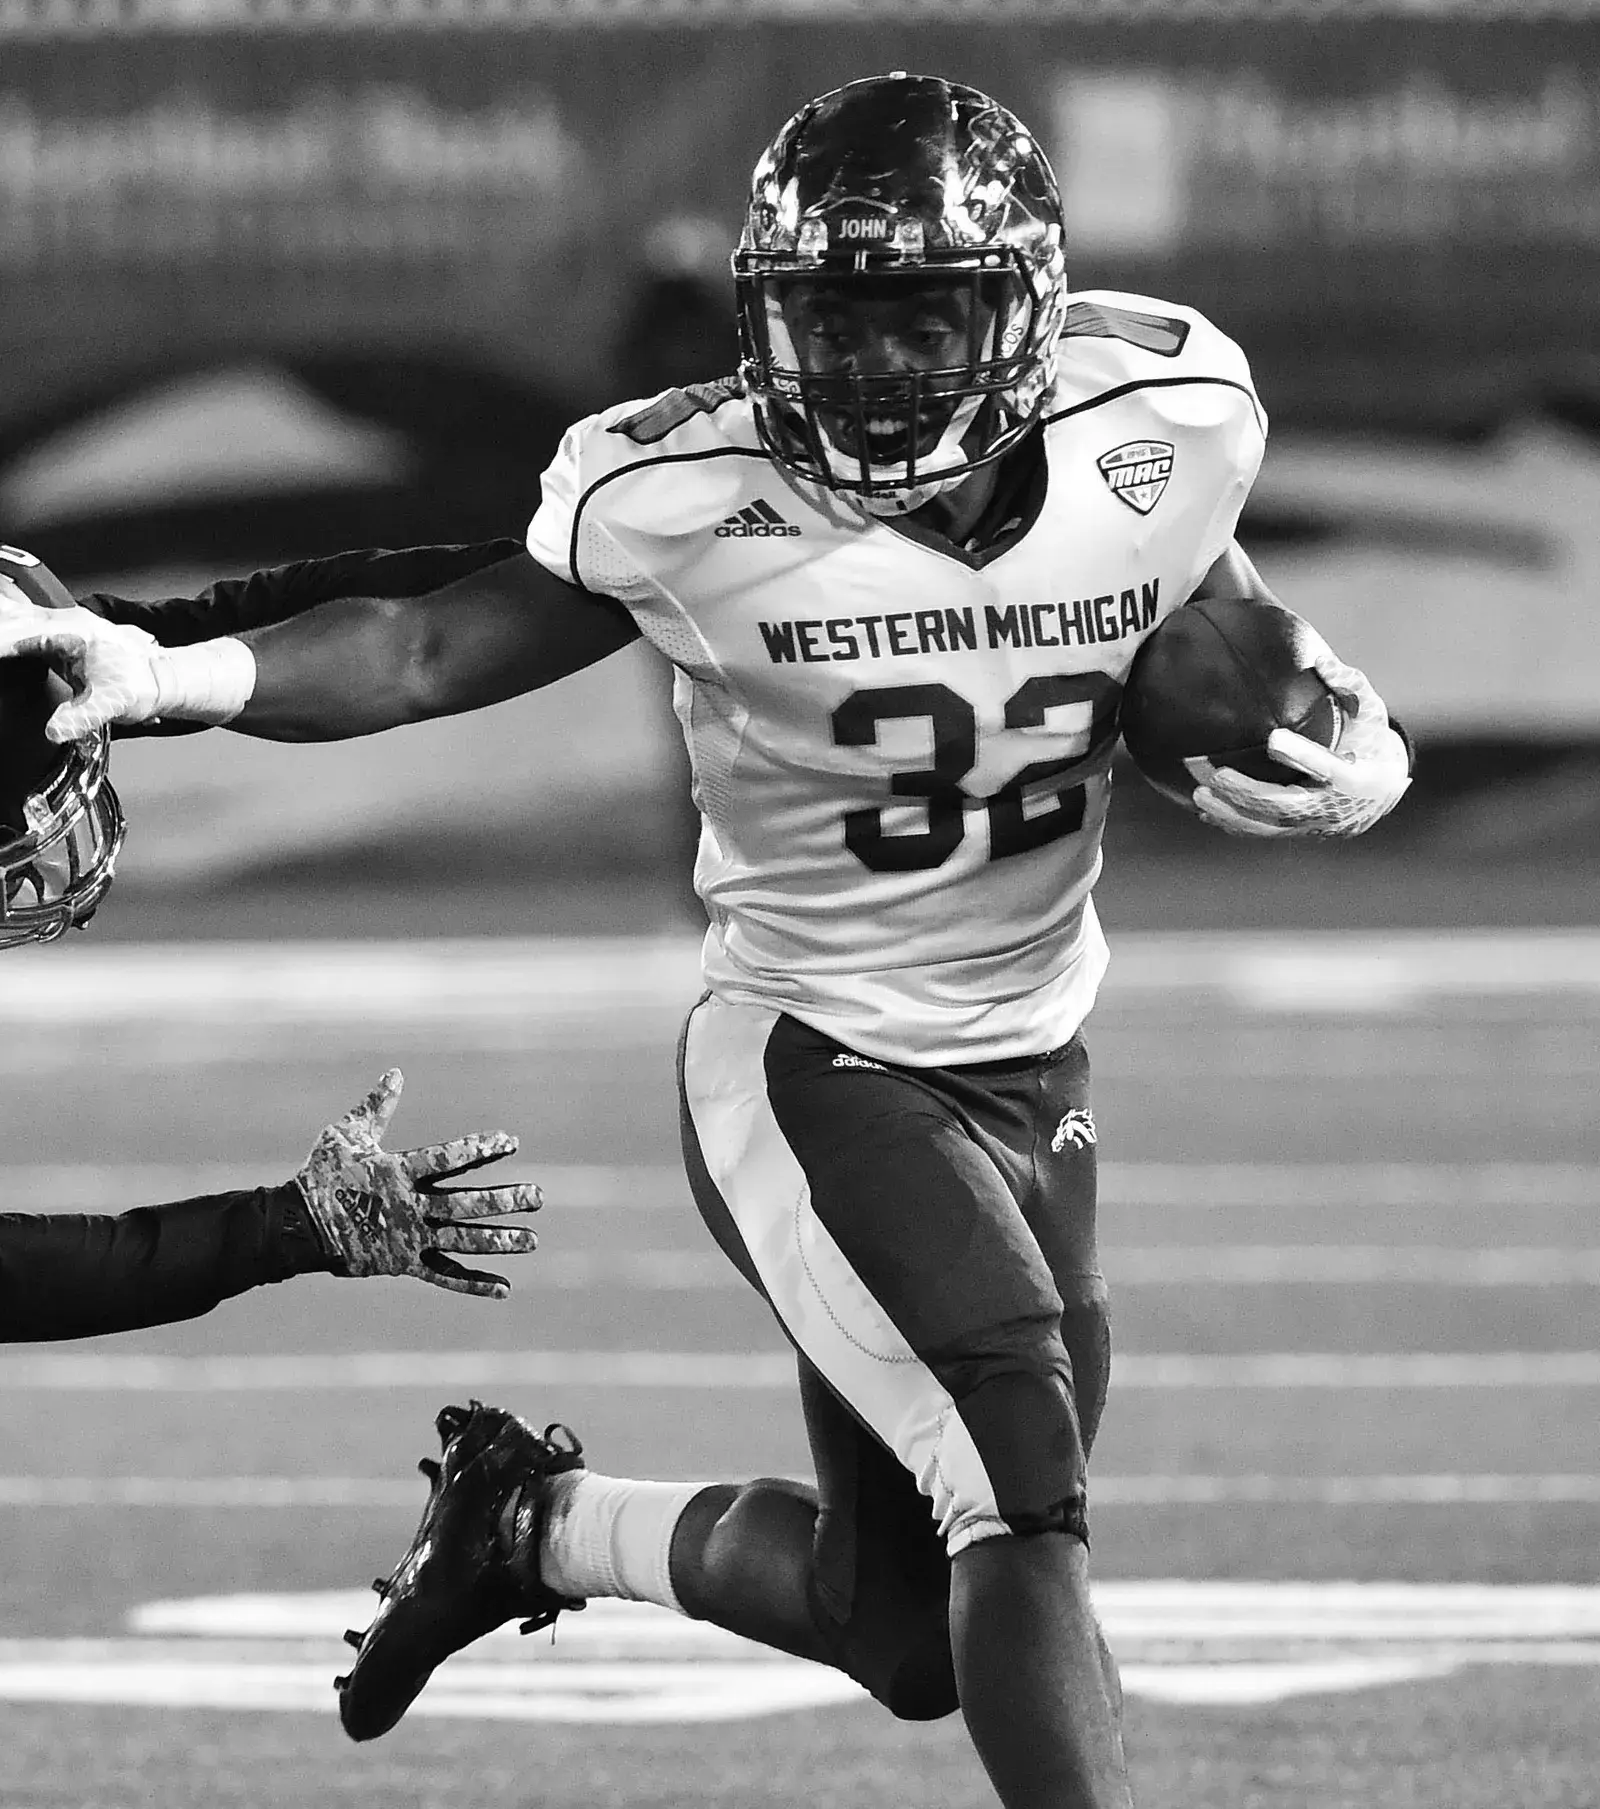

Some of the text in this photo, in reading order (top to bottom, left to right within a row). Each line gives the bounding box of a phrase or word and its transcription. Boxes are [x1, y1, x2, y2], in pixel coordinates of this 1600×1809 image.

[838, 218, 887, 238] JOHN
[1107, 458, 1171, 489] MAC
[714, 523, 802, 538] adidas
[758, 577, 1160, 664] WESTERN MICHIGAN
[831, 669, 1123, 873] 32
